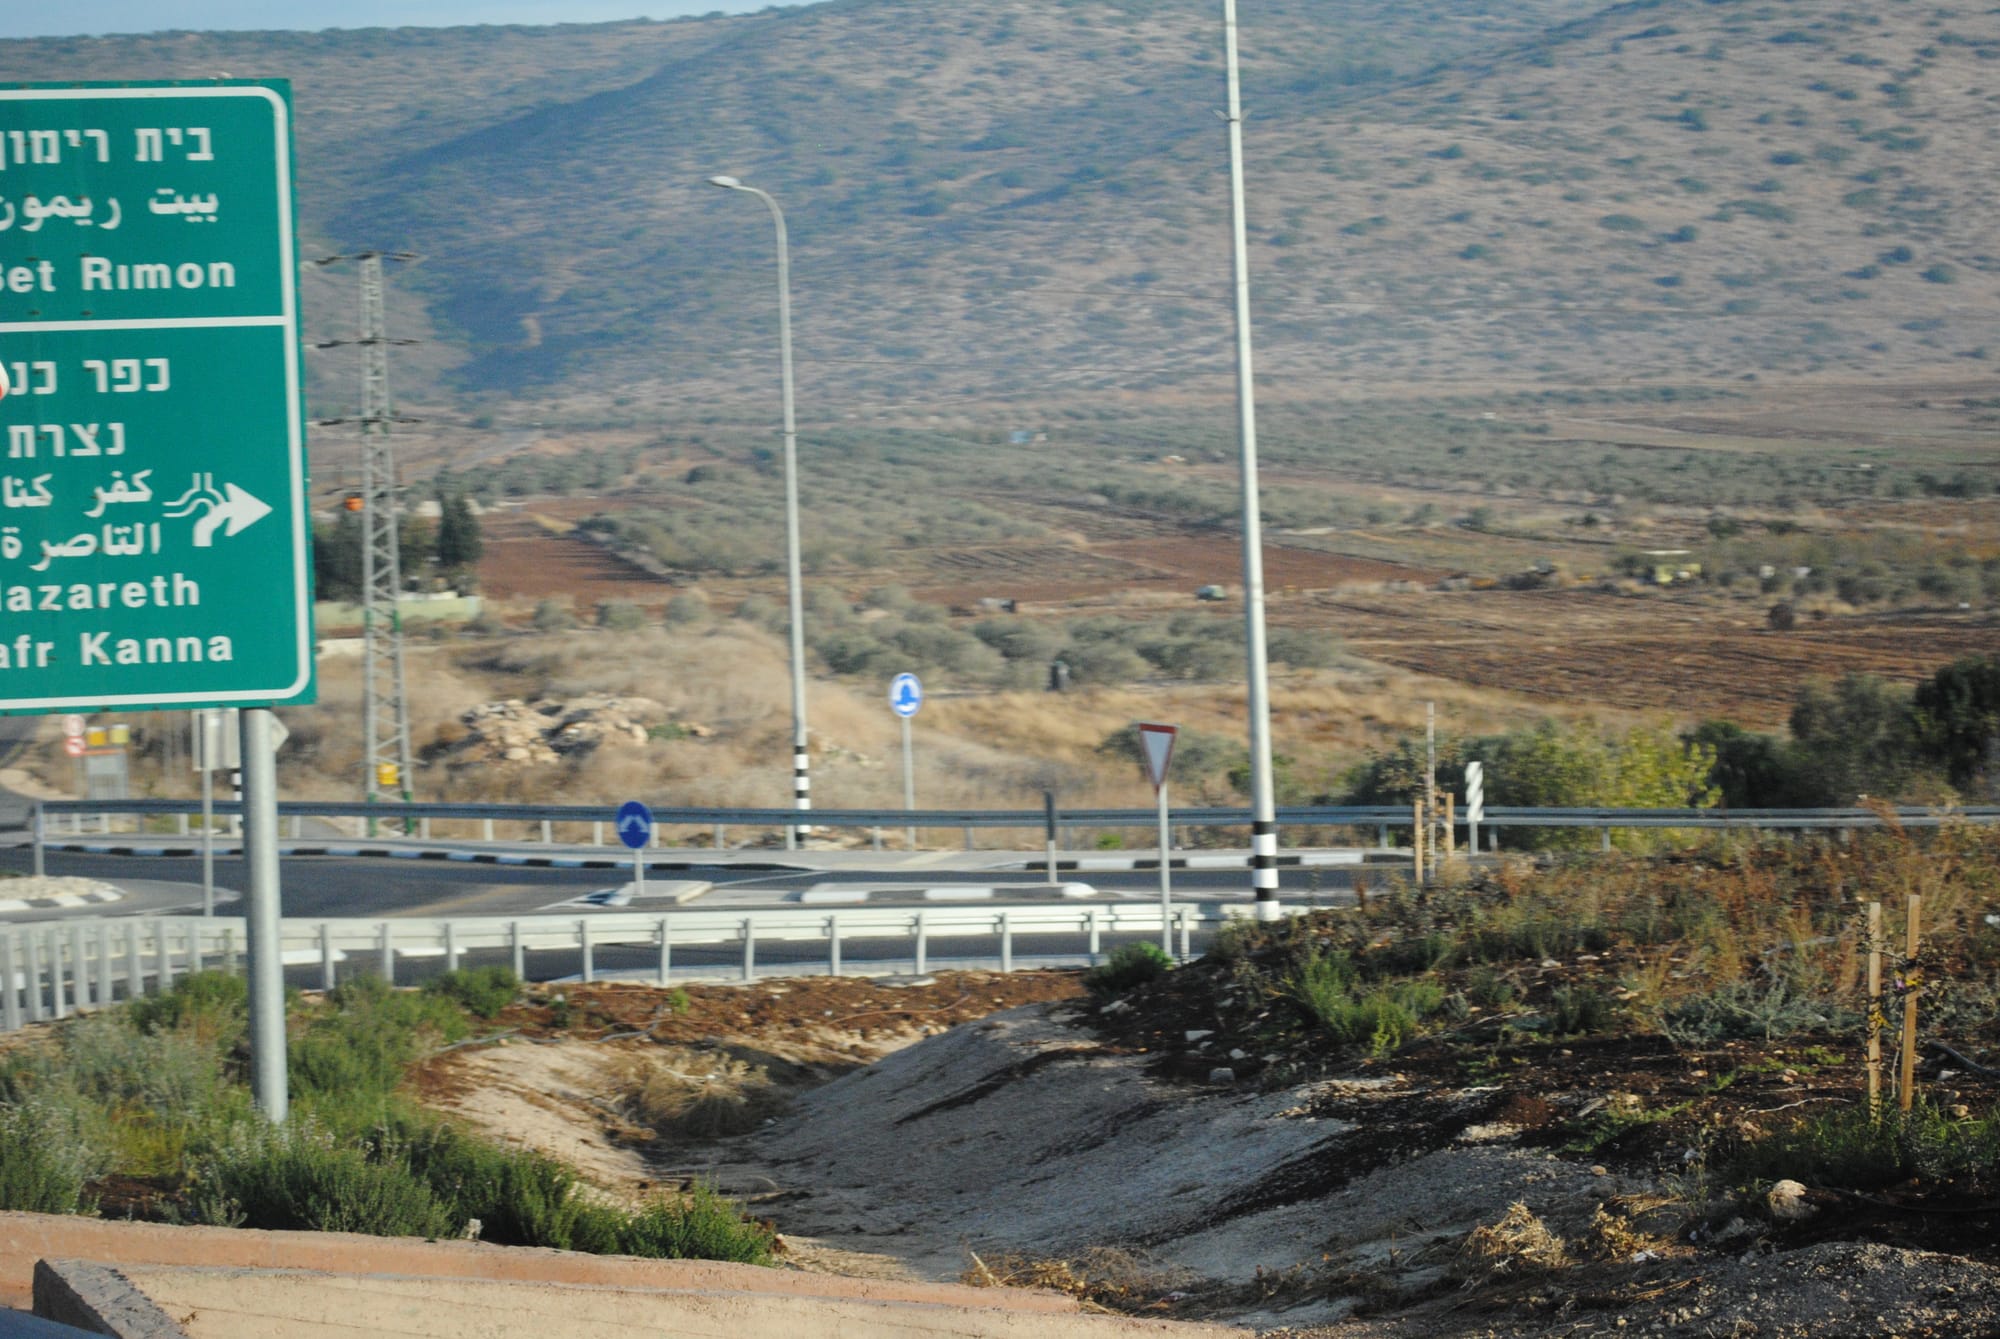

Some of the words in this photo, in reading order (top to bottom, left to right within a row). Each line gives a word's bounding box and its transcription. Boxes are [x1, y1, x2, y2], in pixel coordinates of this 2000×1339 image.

[135, 127, 214, 162] בית
[149, 188, 219, 223] بيت
[0, 260, 56, 293] et
[8, 360, 57, 395] כנ
[83, 357, 170, 393] כפר
[8, 422, 127, 459] נצרת
[2, 473, 53, 508] كنا
[84, 469, 153, 518] كفر
[0, 572, 200, 612] azareth
[80, 631, 233, 667] Kanna
